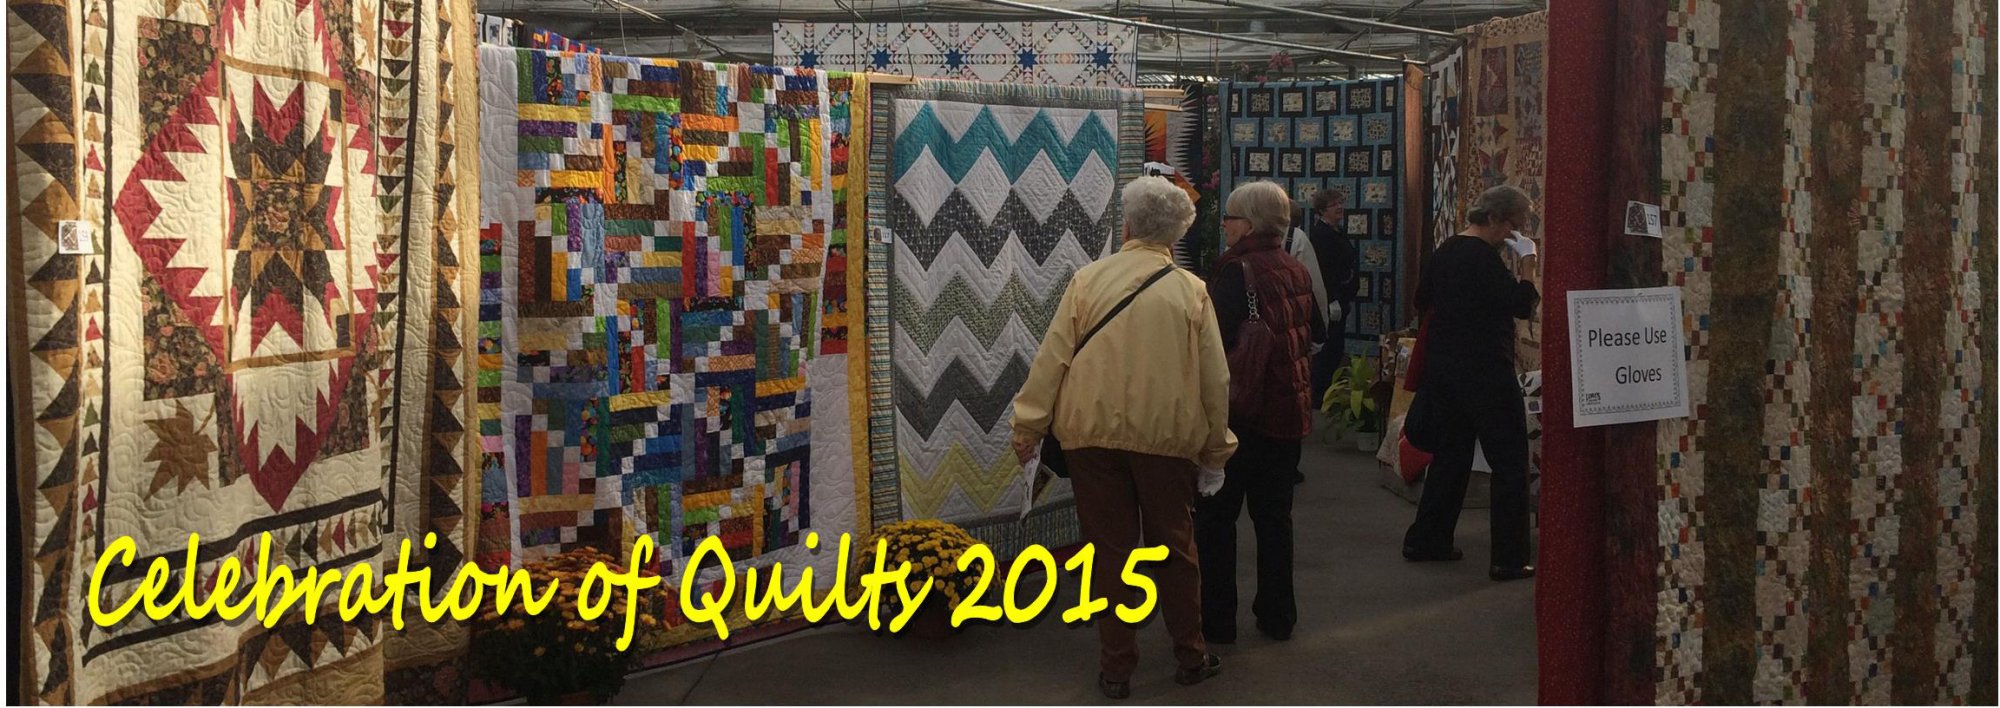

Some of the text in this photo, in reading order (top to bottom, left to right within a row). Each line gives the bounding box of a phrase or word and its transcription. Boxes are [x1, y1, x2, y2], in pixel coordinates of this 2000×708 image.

[1588, 326, 1668, 349] Please Use
[1615, 365, 1663, 385] Gloves
